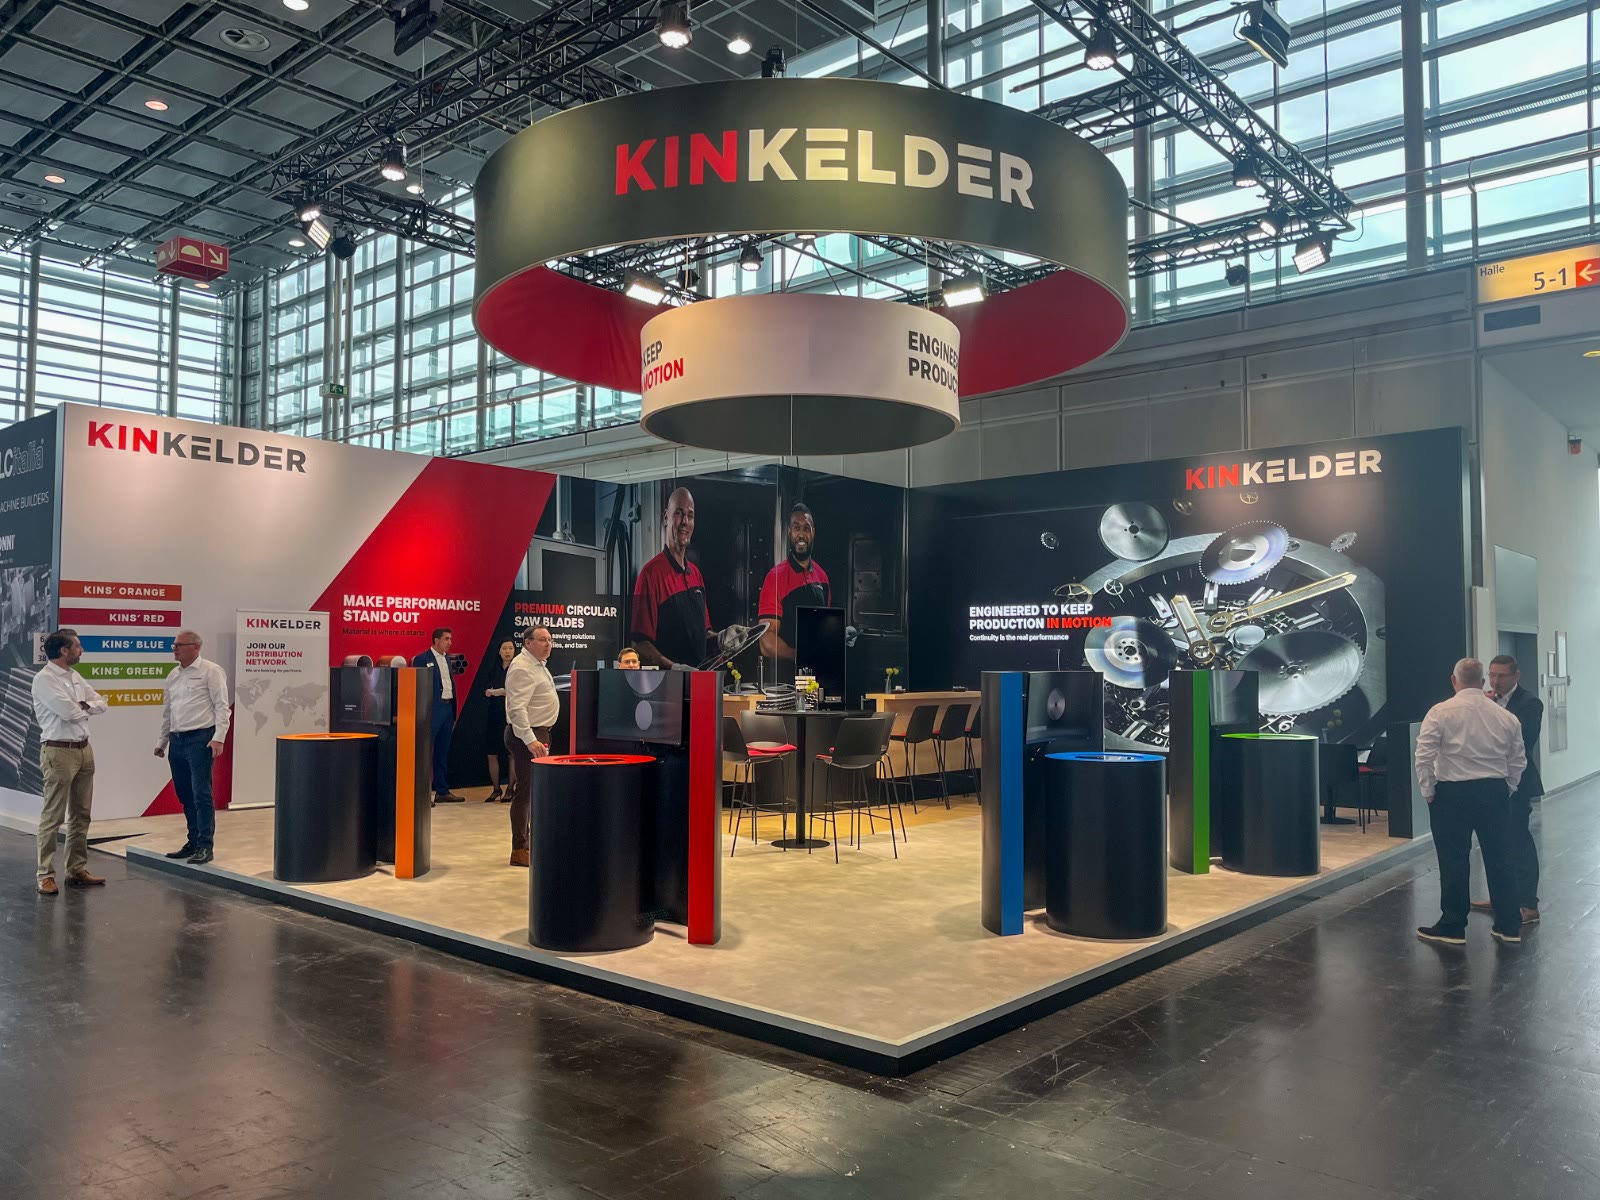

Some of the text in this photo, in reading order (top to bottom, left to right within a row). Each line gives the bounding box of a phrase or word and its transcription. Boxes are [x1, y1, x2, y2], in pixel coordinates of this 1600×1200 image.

[614, 127, 1034, 210] KINKELDER
[1480, 264, 1505, 277] Halle
[1534, 268, 1566, 290] 5-1
[908, 357, 958, 394] PRODUC
[88, 421, 306, 473] KINKELDER
[1185, 450, 1382, 490] KINKELDER
[0, 491, 49, 513] ACHINE BUILDERS
[119, 587, 166, 597] ORANGE
[343, 594, 481, 611] MAKE PERFORMANCE
[514, 602, 617, 617] PREMIUM CIRCULAR
[969, 603, 1093, 617] ENGINEERED TO KEEP
[143, 614, 165, 623] RED
[343, 610, 420, 623] STAND OUT
[514, 616, 585, 628] SAW BLADES
[246, 618, 322, 630] KINKELDER
[969, 616, 1113, 630] PRODUCTION IN MOTION
[406, 629, 425, 637] starts
[551, 632, 571, 640] sawing
[969, 633, 999, 642] Continuity
[1006, 633, 1016, 641] the
[1017, 633, 1028, 641] real
[1029, 633, 1069, 642] performance
[136, 641, 164, 649] BLUE
[246, 650, 303, 658] DISTRIBUTION
[245, 658, 287, 666] NETWORK
[126, 667, 163, 676] GREEN
[116, 693, 162, 702] YELLOW
